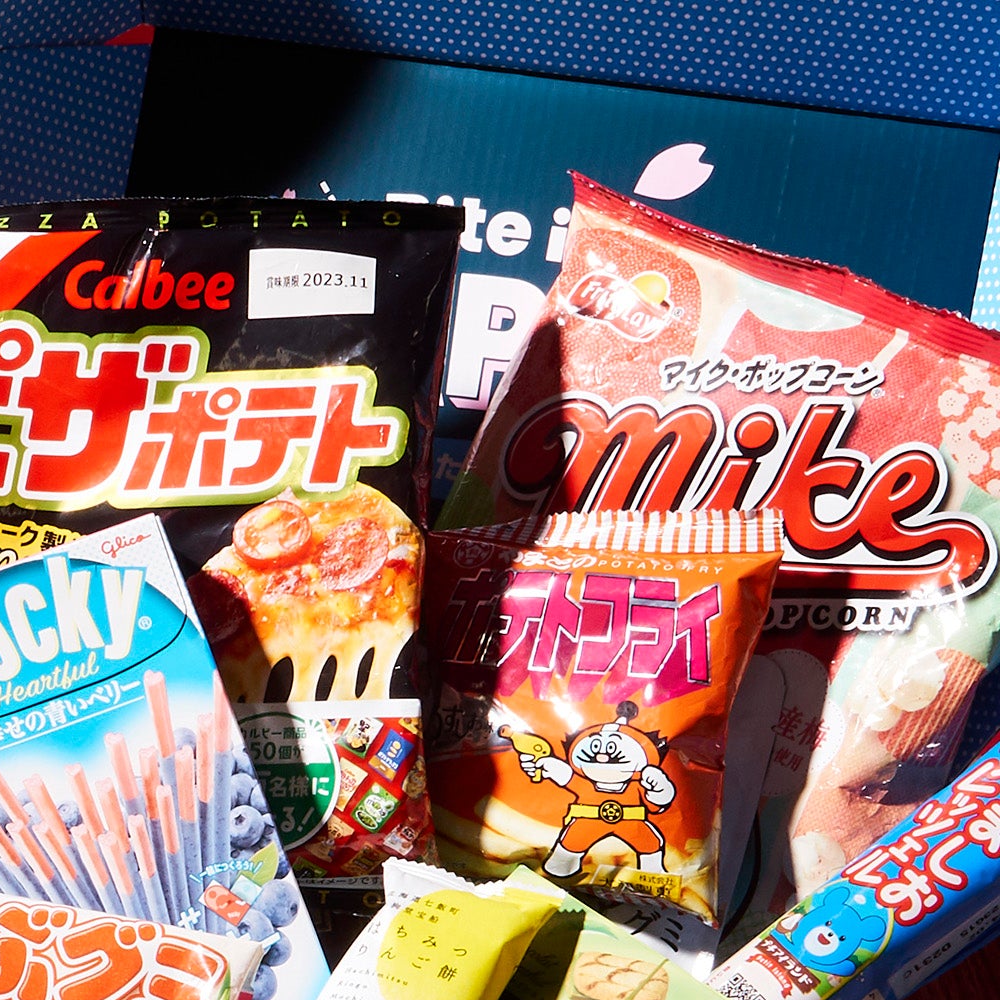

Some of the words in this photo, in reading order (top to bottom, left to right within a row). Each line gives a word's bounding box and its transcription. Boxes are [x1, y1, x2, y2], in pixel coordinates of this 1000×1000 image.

[158, 210, 401, 231] POTATO
[64, 260, 235, 310] Calbee
[302, 273, 368, 289] 2023.11
[664, 358, 880, 392] マイク・ポップコーン
[101, 533, 152, 559] Glico
[598, 559, 673, 571] POTATO
[686, 563, 724, 575] FRY
[443, 567, 721, 685] ポテトフライ
[262, 775, 330, 797] 名様に
[366, 920, 468, 957] はちみつ
[358, 943, 458, 982] りんご餅
[759, 938, 814, 987] プチアイランド
